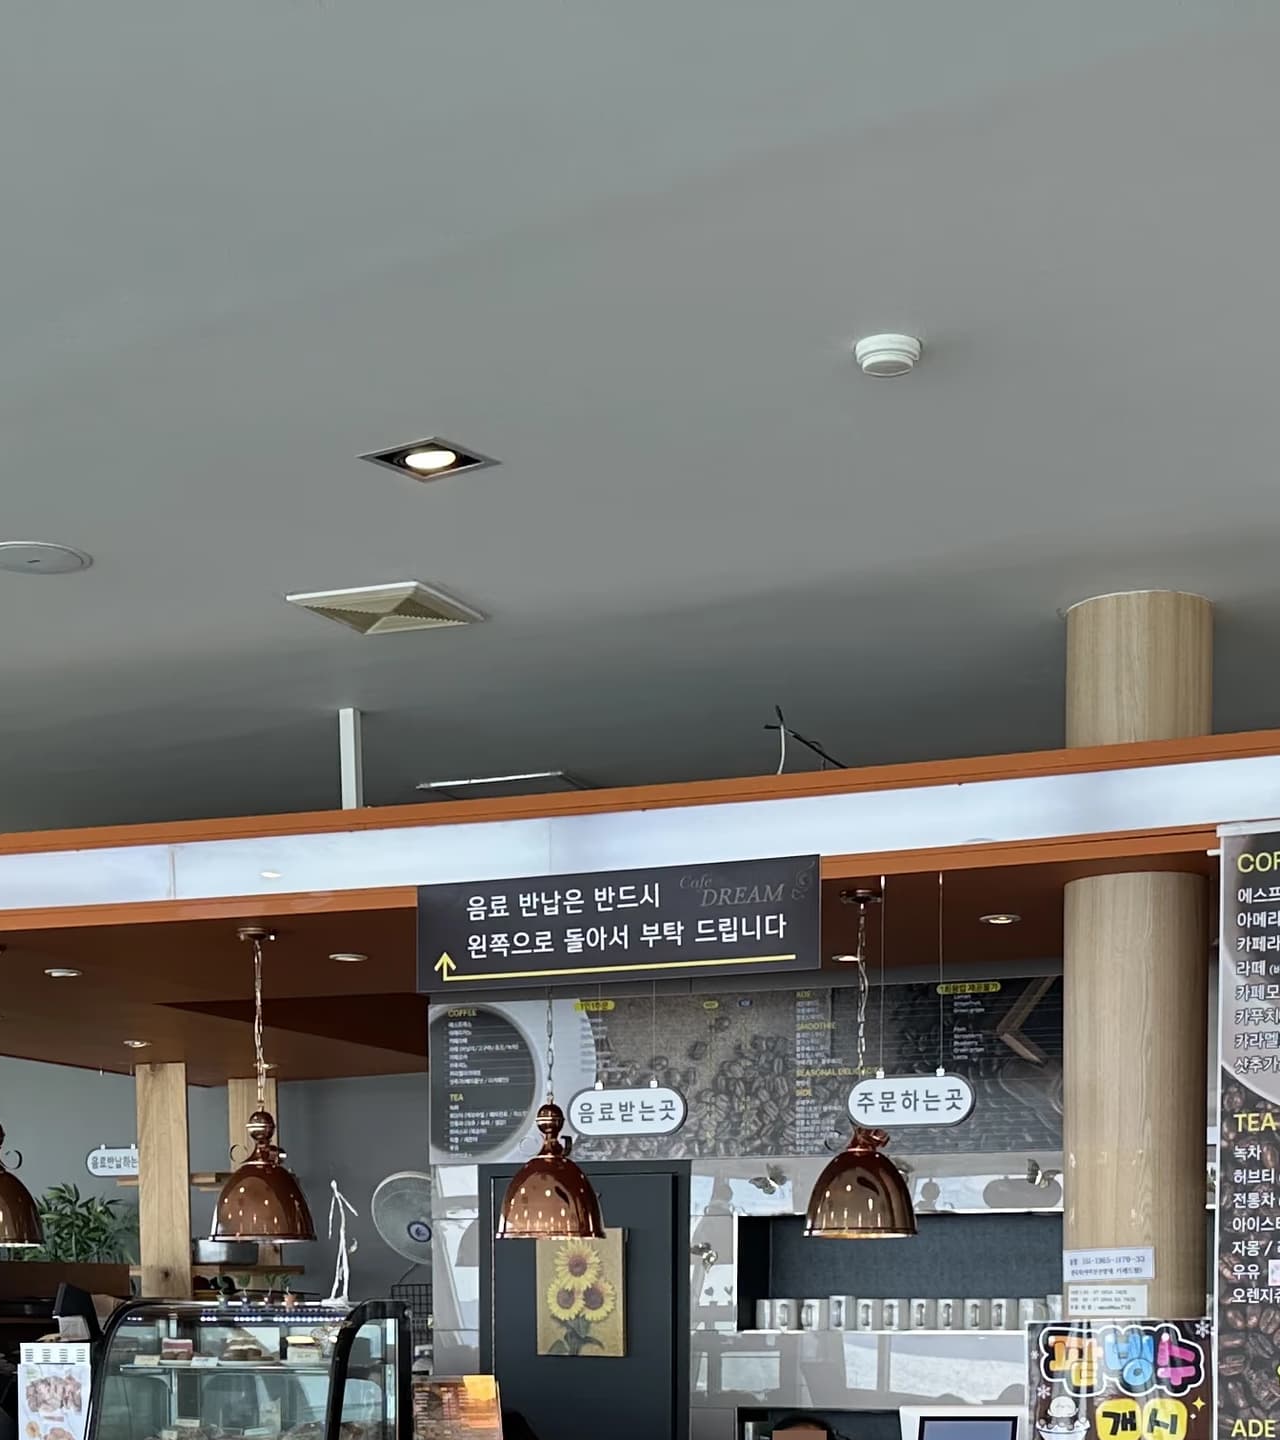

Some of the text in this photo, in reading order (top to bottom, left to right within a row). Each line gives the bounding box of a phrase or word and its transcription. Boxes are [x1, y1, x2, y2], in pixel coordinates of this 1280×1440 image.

[466, 882, 661, 921] 음료 반납은 반드시
[700, 884, 784, 908] DREAM
[467, 912, 787, 960] 왼쪽으로 돌아서 부탁 드립니다
[1236, 960, 1266, 976] 라떼
[450, 1093, 464, 1101] TEA
[857, 1088, 964, 1114] 주문하는곳
[577, 1093, 677, 1124] 음료받는곳
[1233, 1113, 1277, 1132] TEA
[1233, 1145, 1262, 1160] 녹차
[1233, 1168, 1275, 1184] 허브티
[1233, 1192, 1275, 1209] 전통차
[1232, 1240, 1260, 1255] 자몽
[1232, 1264, 1260, 1280] 우유
[1102, 1410, 1179, 1437] 개시
[1231, 1420, 1276, 1438] ADE
